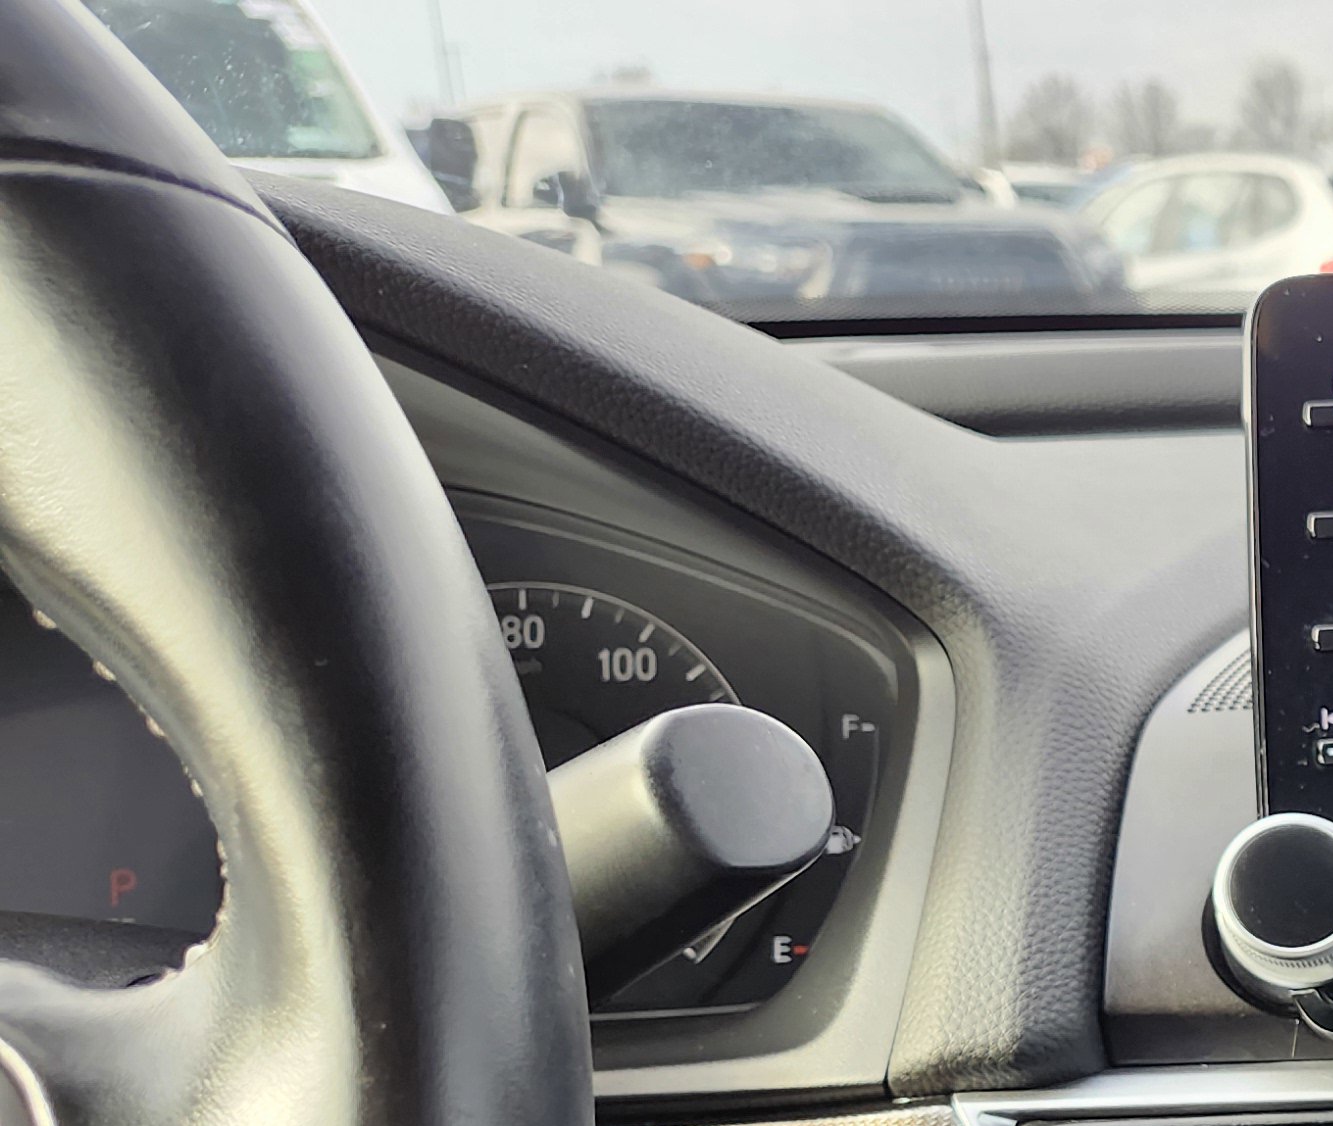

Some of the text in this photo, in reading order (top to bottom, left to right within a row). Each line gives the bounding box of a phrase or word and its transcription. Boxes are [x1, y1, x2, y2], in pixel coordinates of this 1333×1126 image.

[501, 615, 545, 649] 80
[598, 647, 658, 682] 100
[842, 714, 859, 738] F
[110, 869, 137, 905] P
[773, 936, 793, 963] E
